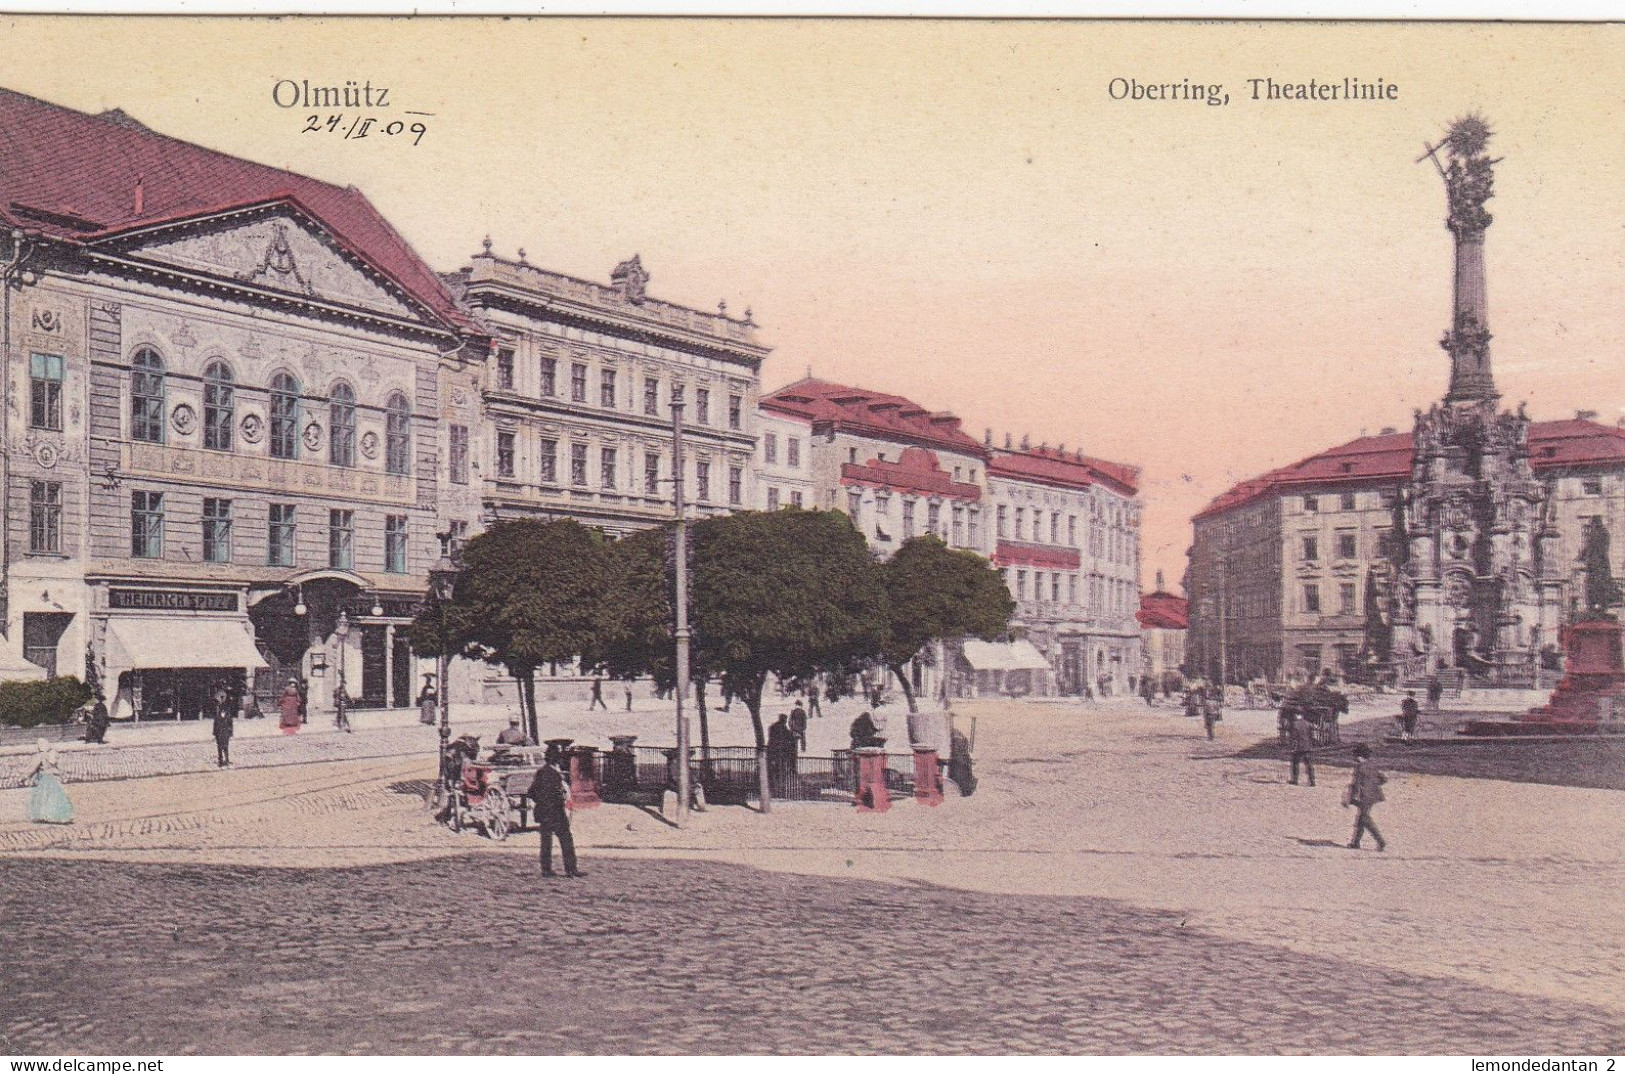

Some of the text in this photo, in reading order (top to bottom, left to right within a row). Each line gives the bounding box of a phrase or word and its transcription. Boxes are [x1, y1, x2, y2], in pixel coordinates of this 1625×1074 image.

[272, 79, 390, 109] Olmütz
[1108, 77, 1399, 107] Oberring, Theaterlinie
[124, 592, 225, 608] HEINRICH SPITZ
